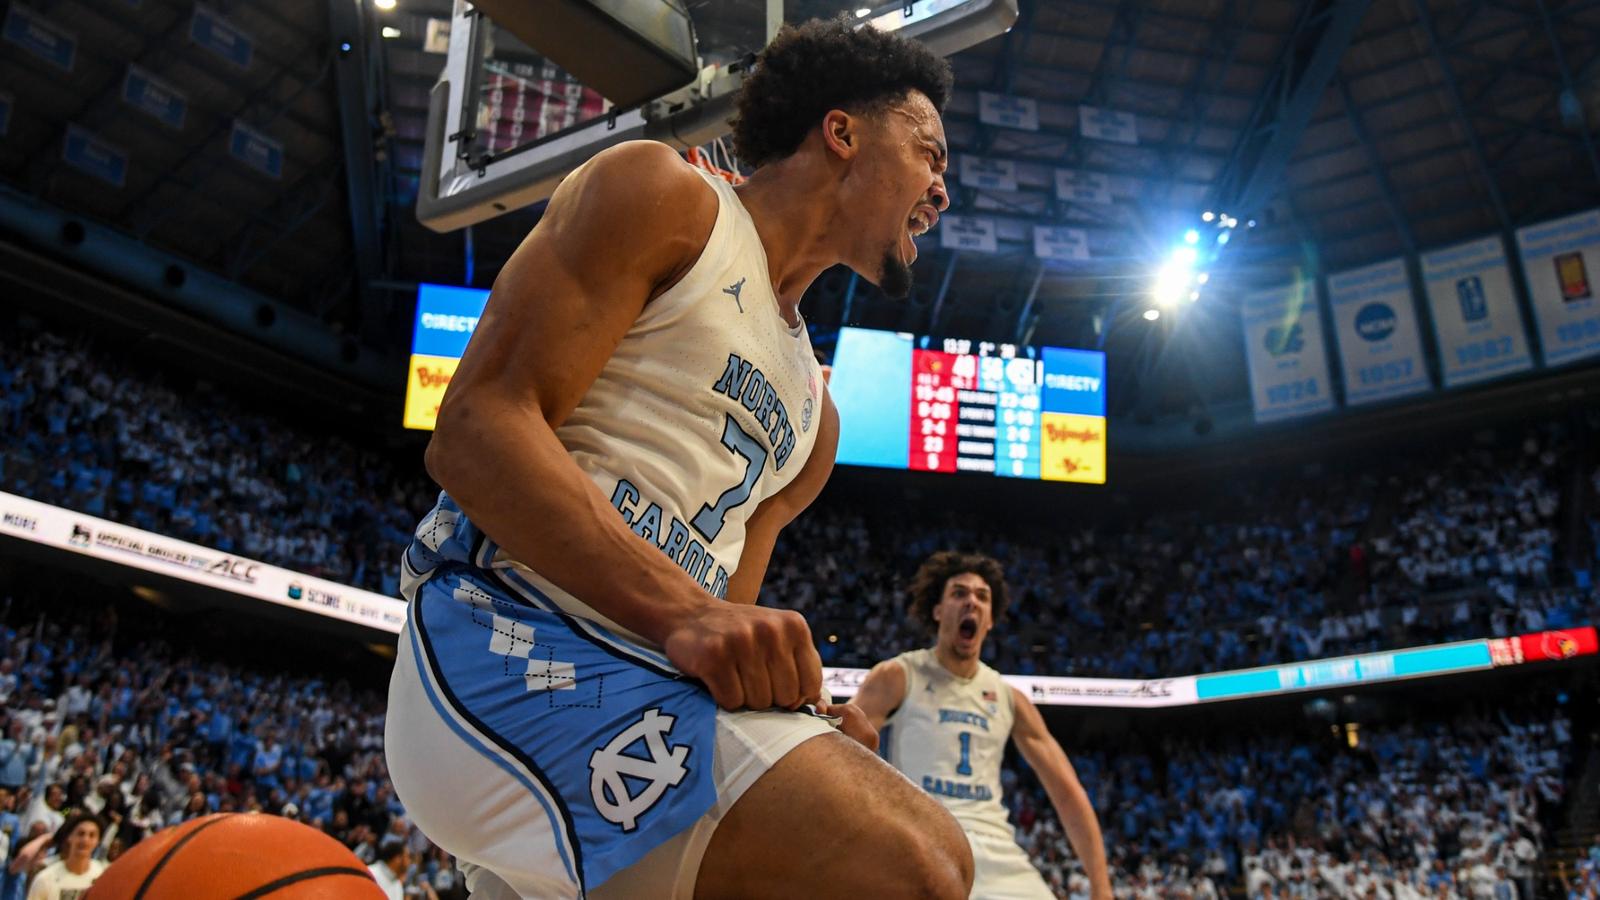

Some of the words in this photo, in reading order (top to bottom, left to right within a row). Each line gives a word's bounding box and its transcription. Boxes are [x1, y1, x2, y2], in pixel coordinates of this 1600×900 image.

[421, 312, 479, 333] DIRECT
[1045, 373, 1100, 392] DIRECTV
[1359, 357, 1415, 385] 1957
[712, 353, 797, 471] NORTH
[689, 412, 769, 544] 7
[207, 557, 260, 582] ACC
[938, 708, 990, 732] NORTH
[956, 731, 973, 776] 1
[922, 775, 993, 801] CAROLINA
